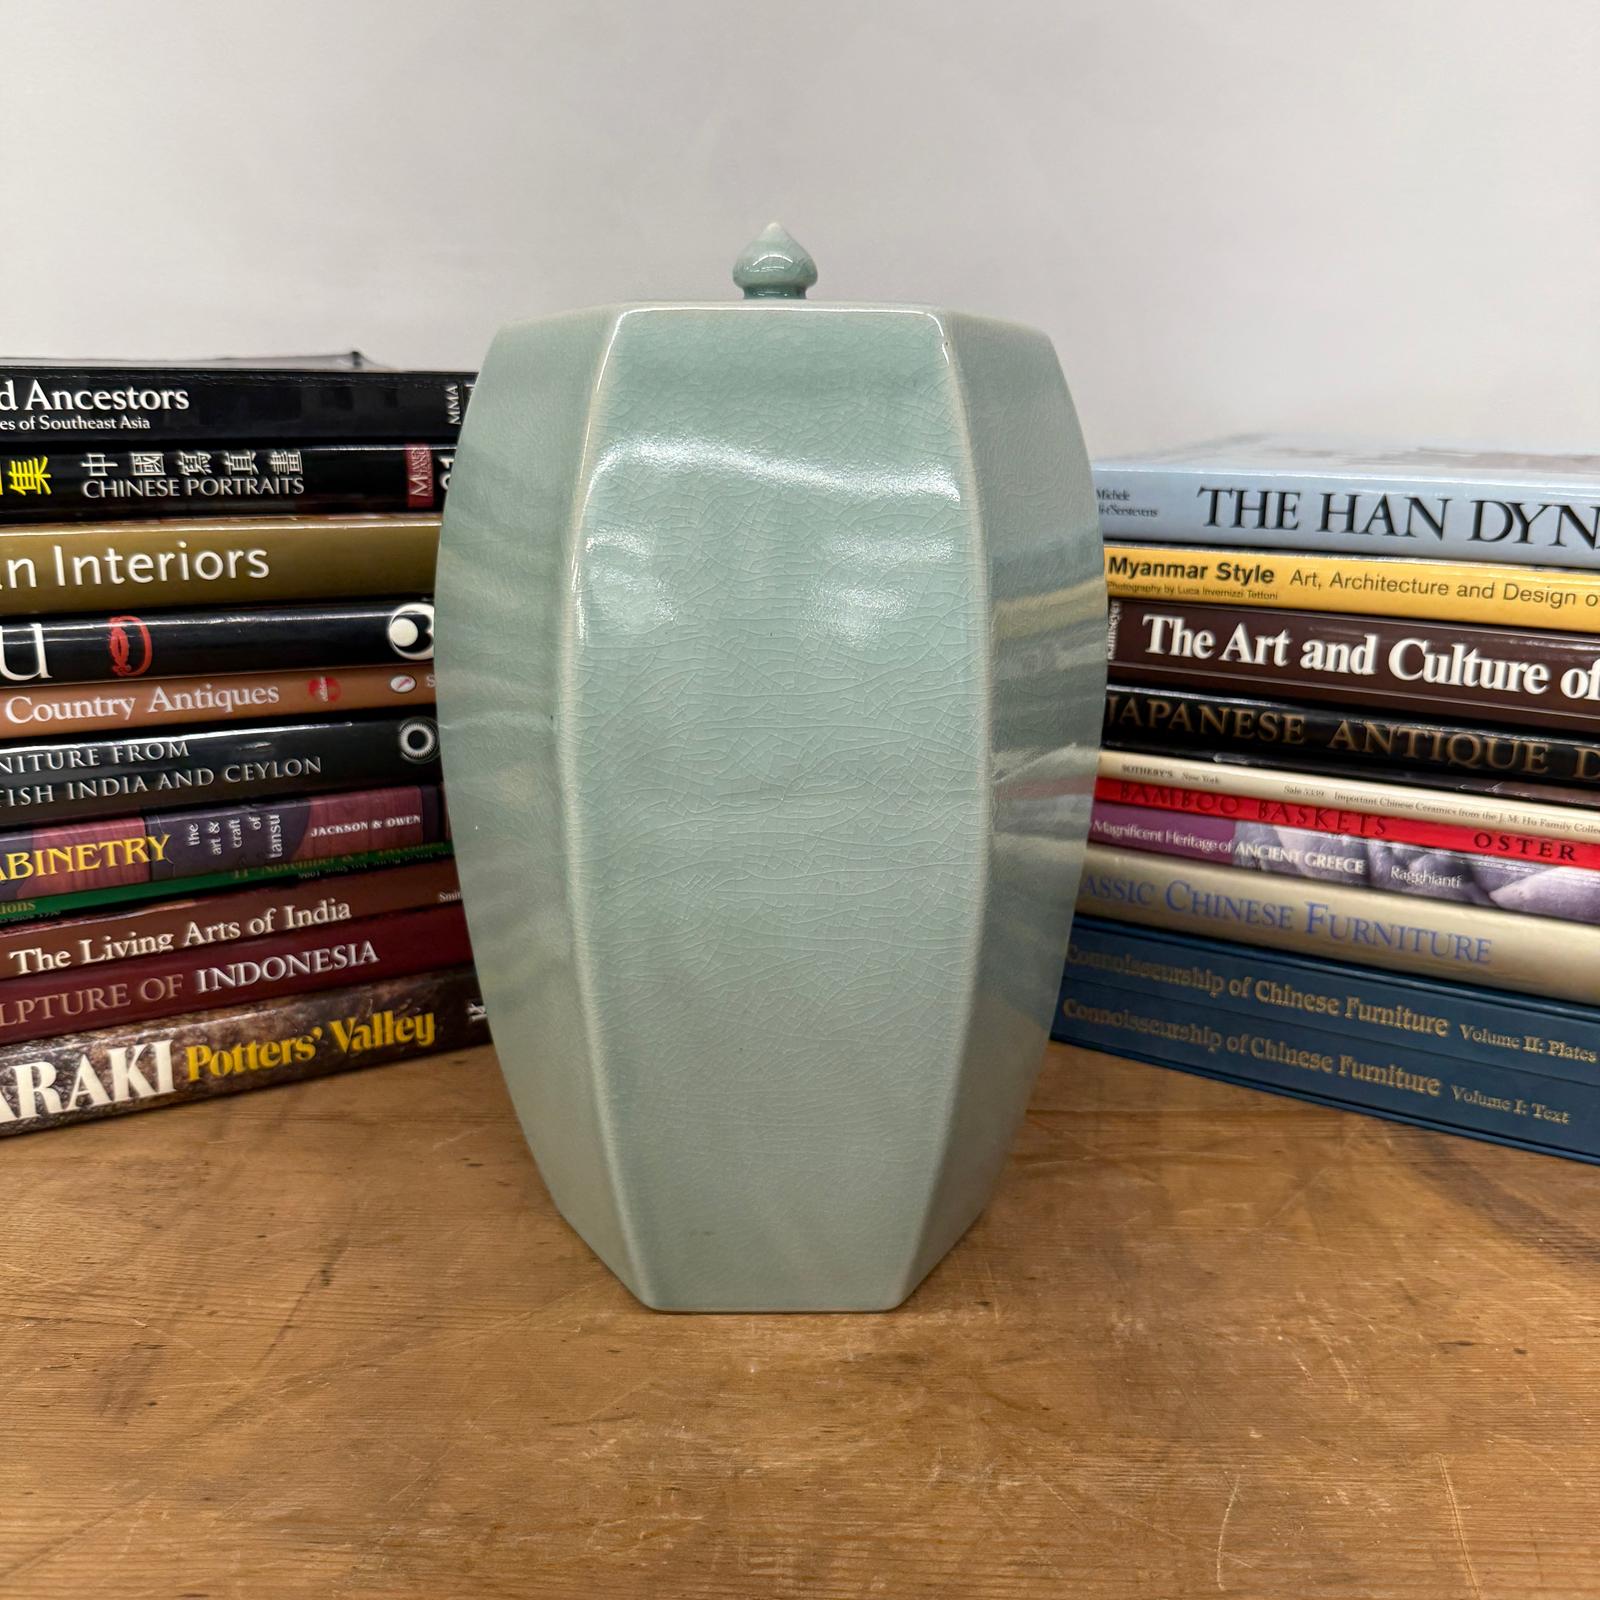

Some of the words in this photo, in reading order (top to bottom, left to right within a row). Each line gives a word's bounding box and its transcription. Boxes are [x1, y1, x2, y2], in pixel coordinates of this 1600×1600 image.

[24, 379, 190, 411] Ancestors
[446, 384, 461, 425] MMA
[19, 415, 35, 431] of
[39, 415, 117, 431] Southeast
[120, 415, 151, 430] Asia
[0, 455, 52, 497] 集
[82, 478, 181, 499] CHINESE
[186, 477, 305, 498] PORTRAITS
[1196, 486, 1301, 532] THE
[1316, 491, 1453, 541] HAN
[1467, 499, 1600, 550] DYN
[0, 555, 37, 590] n
[54, 540, 270, 587] Interiors
[1108, 556, 1208, 580] Myanmar
[1215, 562, 1275, 586] Style
[1289, 569, 1322, 591] Art,
[1329, 571, 1449, 596] Architecture
[1457, 581, 1495, 600] and
[1503, 582, 1576, 609] Design
[1585, 592, 1600, 607] o
[1163, 585, 1175, 597] by
[1177, 585, 1200, 596] Luca
[1202, 586, 1244, 599] Invernizzi
[1247, 589, 1278, 601] Tettoni
[1141, 613, 1216, 660] The
[1219, 621, 1294, 668] Art
[1300, 632, 1380, 677] and
[1388, 637, 1550, 696] Culture
[1560, 656, 1600, 702] of
[5, 695, 137, 725] Country
[148, 684, 280, 714] Antiques
[112, 741, 190, 765] FROM
[1106, 692, 1306, 745] JAPANESE
[1327, 718, 1550, 775] ANTIQUE
[67, 775, 150, 801] INDIA
[157, 767, 215, 791] AND
[224, 756, 322, 784] CEYLON
[1121, 763, 1174, 779] SOTHEBY'S
[1181, 771, 1200, 784] New
[1202, 773, 1220, 785] York
[1283, 784, 1301, 796] Sale
[1334, 791, 1378, 806] Important
[1379, 797, 1414, 809] Chinese
[1415, 801, 1458, 816] Ceramics
[1458, 807, 1480, 819] from
[1482, 811, 1498, 821] the
[1540, 818, 1573, 832] Family
[186, 822, 201, 847] the
[227, 817, 242, 848] craft
[248, 815, 262, 831] of
[268, 813, 283, 859] tansu
[309, 821, 369, 838] JACKSON
[371, 819, 383, 830] &
[386, 814, 422, 827] OWEN
[1120, 778, 1241, 815] BAMBOO
[1256, 799, 1387, 836] BASKETS
[1473, 832, 1576, 862] OSTER
[210, 836, 223, 855] art
[1092, 818, 1164, 842] Magnificent
[1165, 829, 1218, 854] Heritage
[1218, 839, 1233, 853] of
[1234, 842, 1306, 865] ANCIENT
[1304, 851, 1367, 876] GREECE
[1390, 864, 1464, 890] Ragghianti
[0, 899, 36, 915] ions
[1164, 878, 1297, 931] CHINESE
[1305, 901, 1493, 965] FURNITURE
[9, 947, 72, 975] The
[78, 931, 175, 965] Living
[183, 920, 242, 947] Arts
[249, 907, 277, 936] of
[284, 897, 352, 928] India
[0, 983, 131, 1027] LPTURE
[139, 973, 184, 1001] OF
[195, 939, 381, 994] INDONESIA
[1229, 976, 1253, 998] of
[1255, 979, 1340, 1018] Chinese
[1345, 996, 1449, 1038] Furniture
[1459, 1023, 1520, 1050] Volume
[1548, 1039, 1598, 1065] Plates
[184, 1025, 323, 1082] Potters'
[329, 1010, 436, 1053] Valley
[1062, 997, 1222, 1053] Connoisseurship
[1226, 1033, 1251, 1055] of
[1251, 1036, 1335, 1074] Chinese
[1339, 1054, 1442, 1098] Furniture
[1451, 1084, 1512, 1112] Volume
[1531, 1102, 1573, 1125] Text
